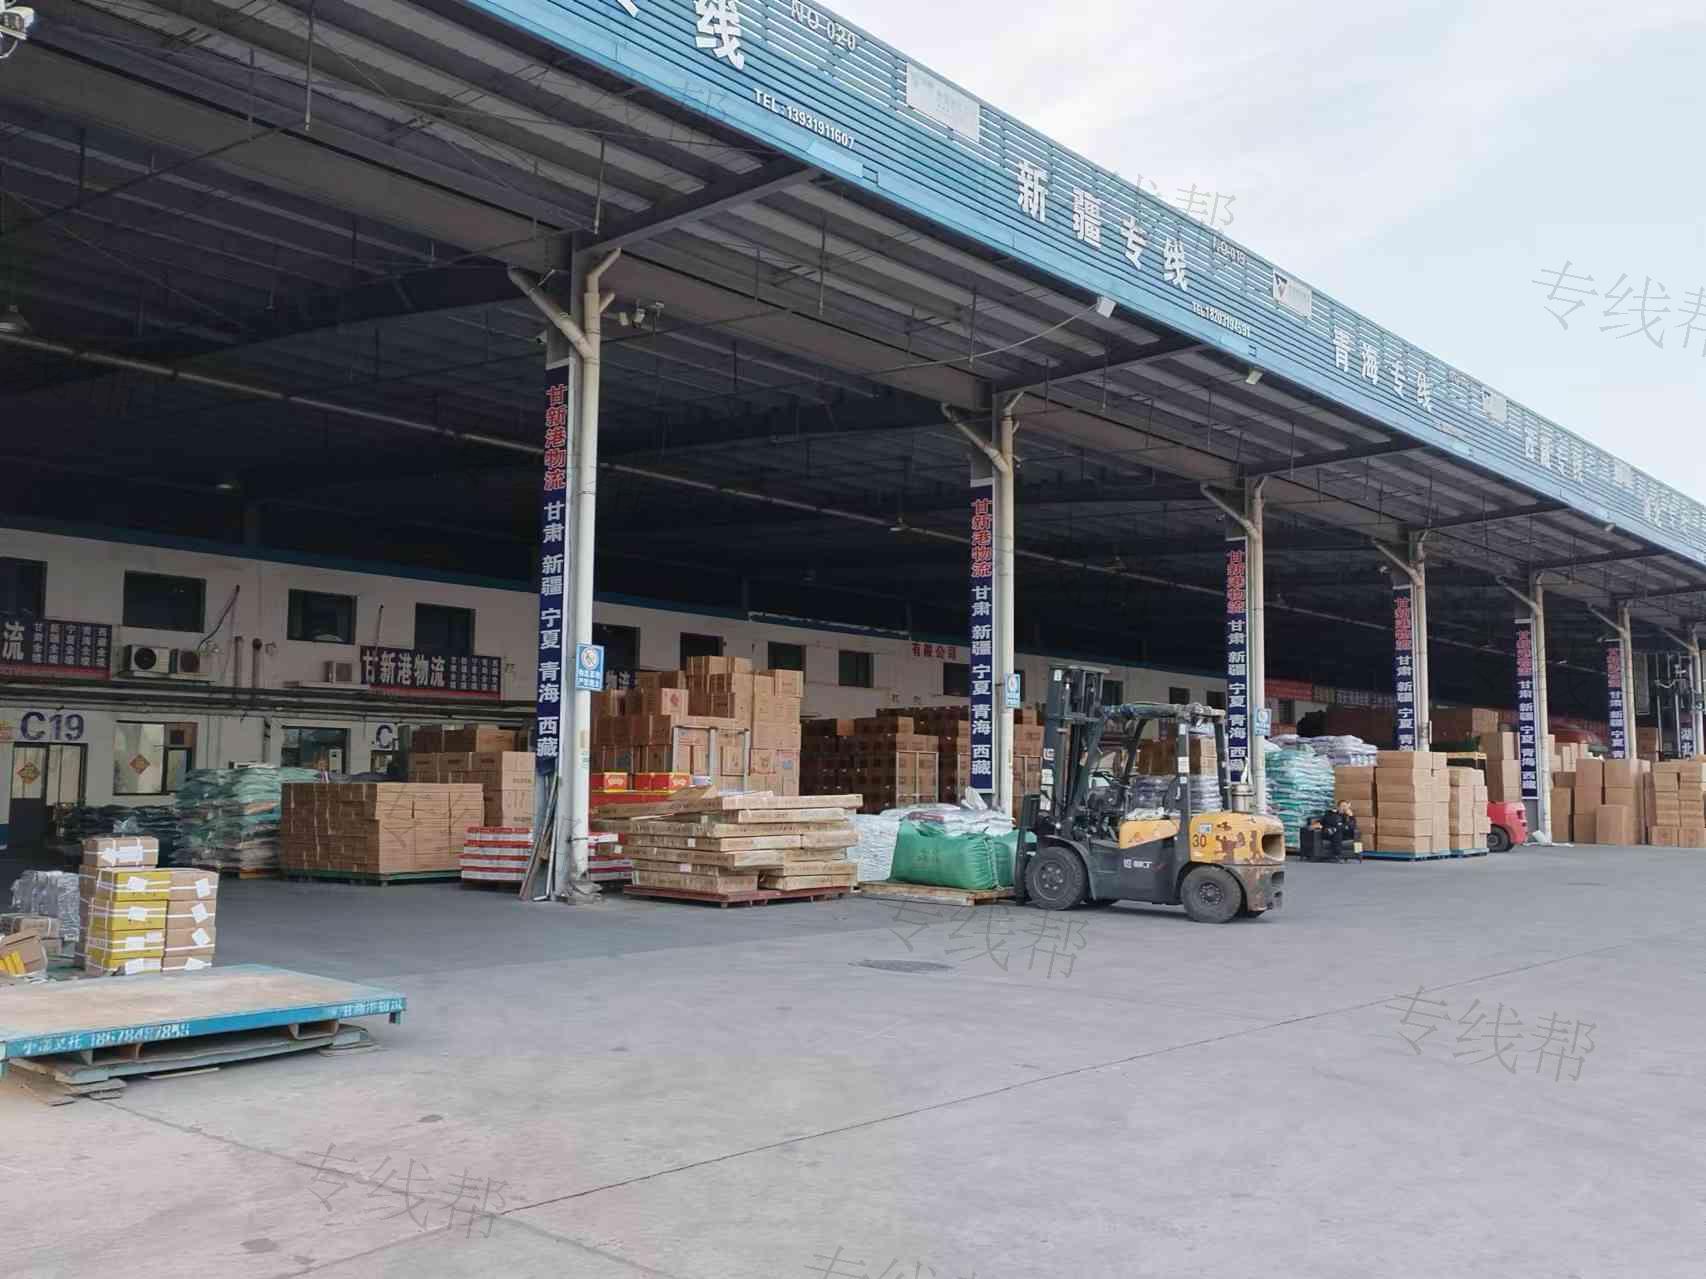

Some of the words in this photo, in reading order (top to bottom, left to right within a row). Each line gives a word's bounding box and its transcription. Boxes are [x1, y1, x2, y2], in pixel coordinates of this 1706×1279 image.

[1017, 160, 1188, 291] 新疆专线
[1332, 328, 1431, 413] 青海专线
[544, 383, 568, 491] 甘新港物流
[542, 500, 565, 543] 甘肃
[971, 498, 993, 577] 甘新港物流
[541, 554, 564, 596] 新疆
[971, 585, 991, 616] 甘肃
[1, 621, 25, 660] 流
[541, 608, 561, 650] 宁夏
[971, 624, 991, 656] 新疆
[1228, 620, 1245, 645] 甘肃
[362, 649, 446, 687] 甘新港物流
[971, 664, 991, 696] 宁夏
[1228, 651, 1245, 676] 新疆
[538, 661, 560, 704] 青海
[1228, 683, 1245, 707] 宁夏
[21, 711, 84, 740] C19
[536, 716, 559, 757] 西藏
[971, 704, 991, 735] 青海
[1228, 714, 1245, 739] 青海
[971, 744, 991, 775] 西藏
[1192, 835, 1207, 848] 30
